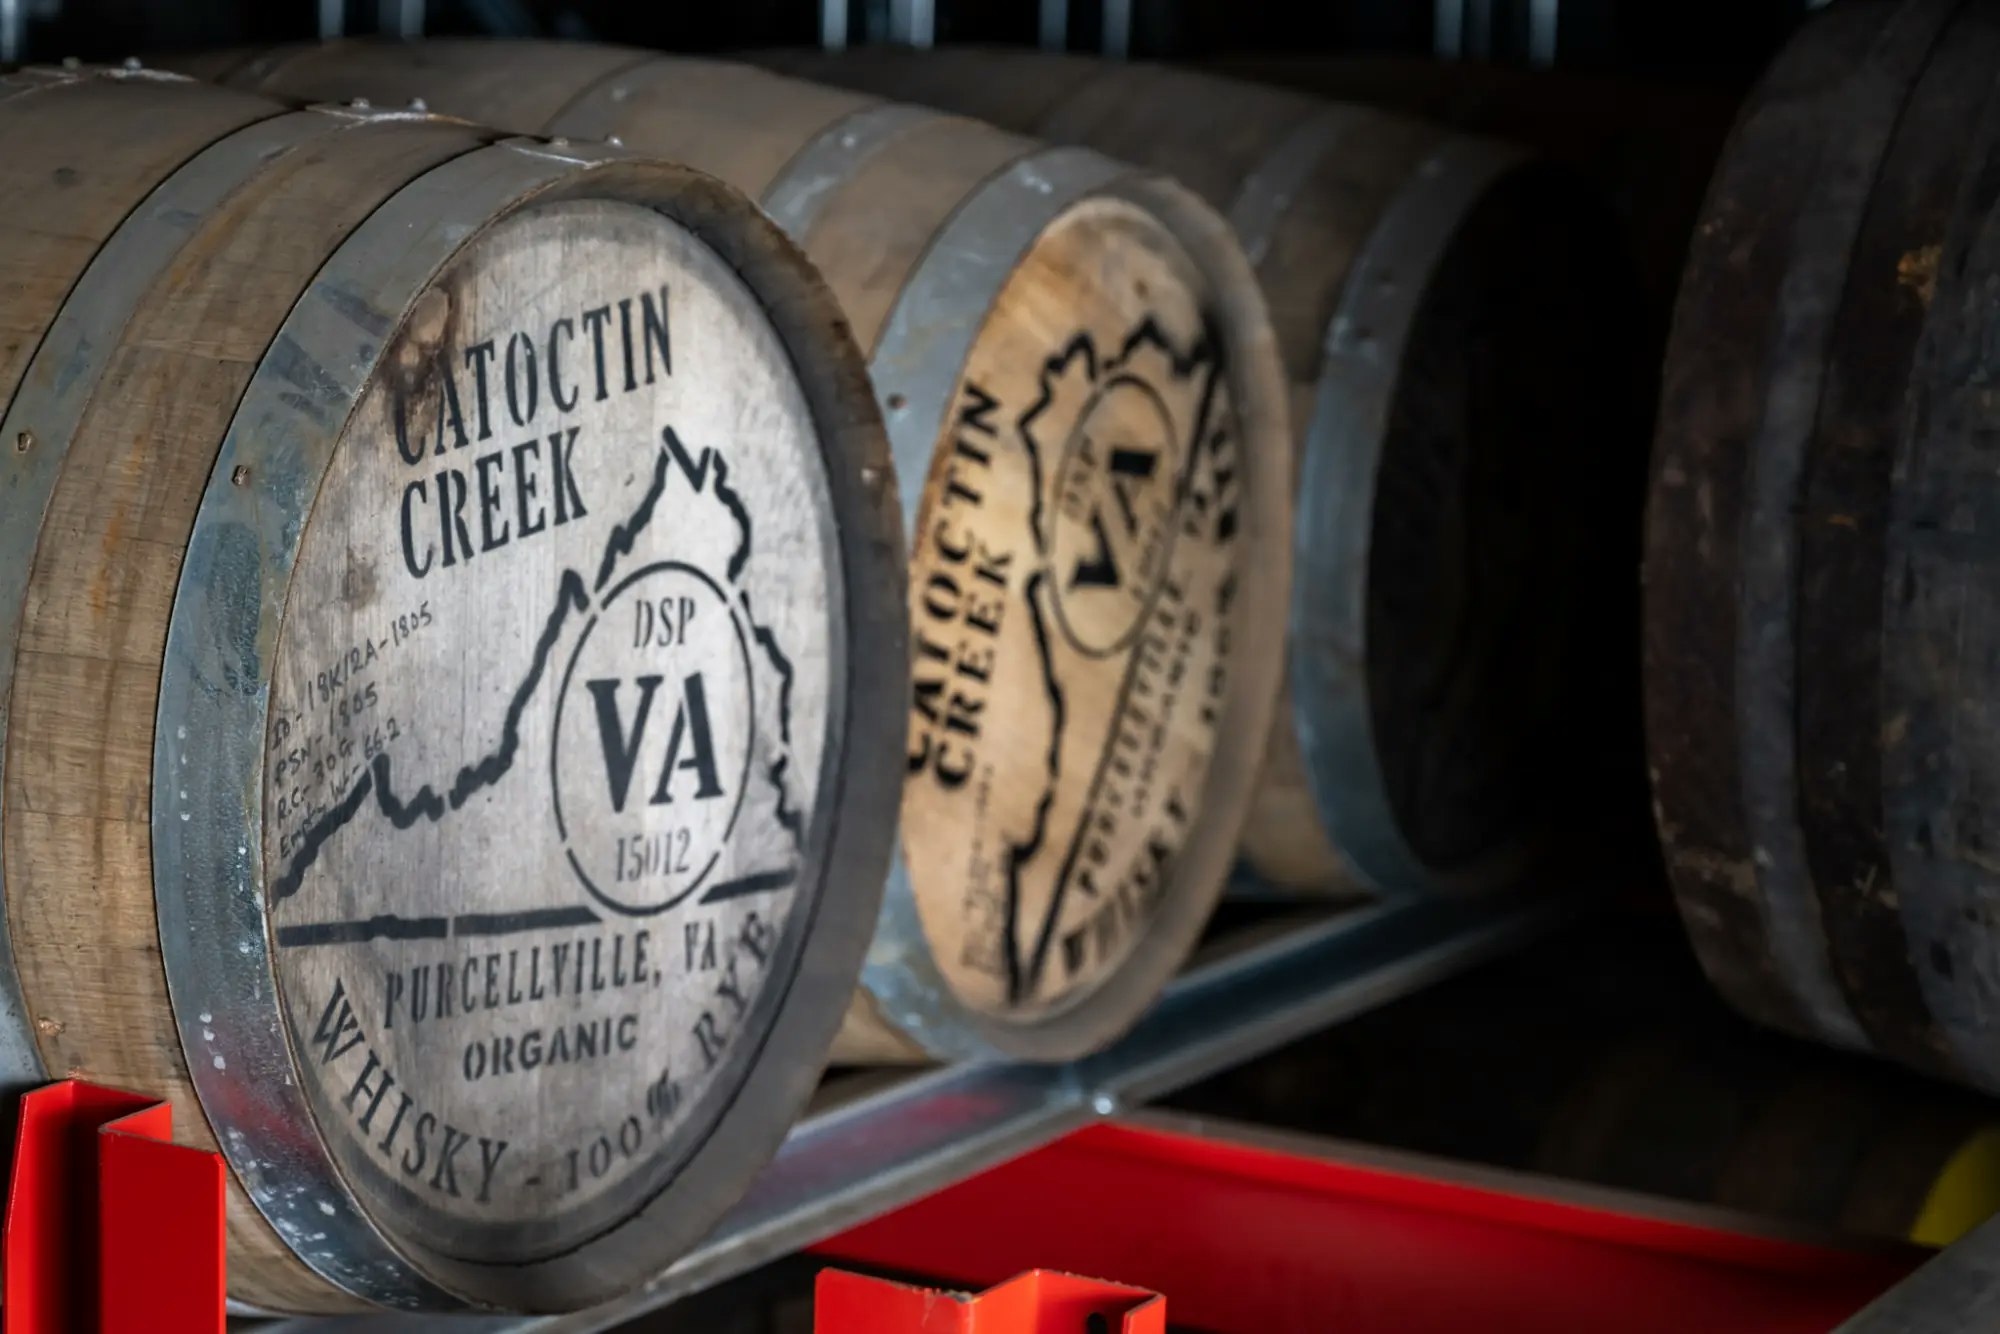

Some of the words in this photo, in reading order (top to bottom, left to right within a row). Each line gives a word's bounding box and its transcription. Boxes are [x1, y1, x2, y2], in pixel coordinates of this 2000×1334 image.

[394, 283, 672, 466] CATOCTIN
[401, 426, 588, 579] CREEK
[633, 596, 695, 649] DSP
[934, 548, 1010, 787] CREEK
[585, 670, 725, 813] VA
[616, 828, 691, 882] 15012
[383, 929, 661, 1030] PURCELLVILLE,
[684, 918, 716, 973] VA
[312, 978, 507, 1201] WHISKY
[692, 911, 775, 1071] RYE
[462, 1013, 639, 1082] ORGANIC
